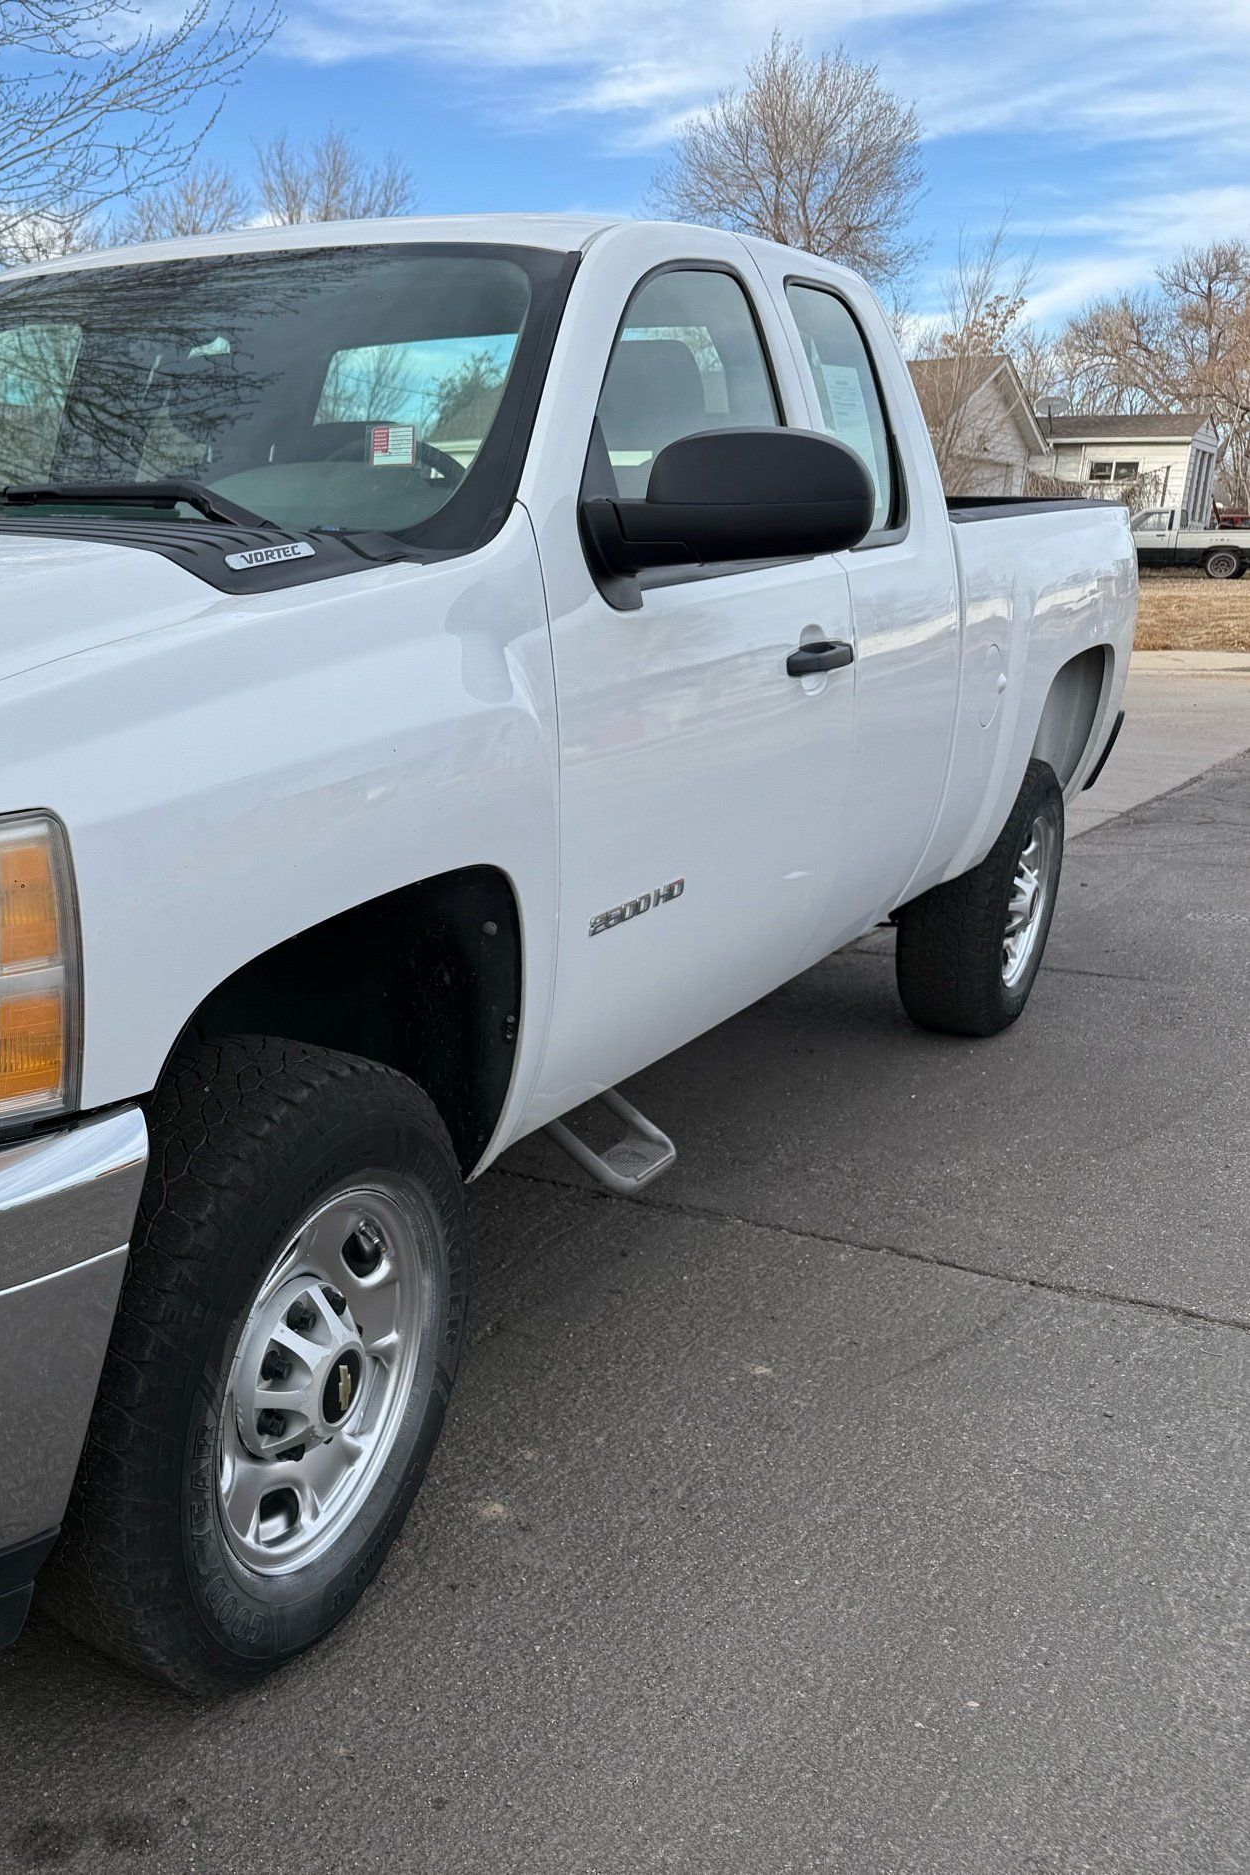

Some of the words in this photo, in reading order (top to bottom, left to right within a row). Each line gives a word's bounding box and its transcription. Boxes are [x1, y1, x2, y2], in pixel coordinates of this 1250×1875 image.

[241, 545, 301, 565] VORTEC
[588, 893, 651, 937] 2500
[653, 878, 685, 908] HD
